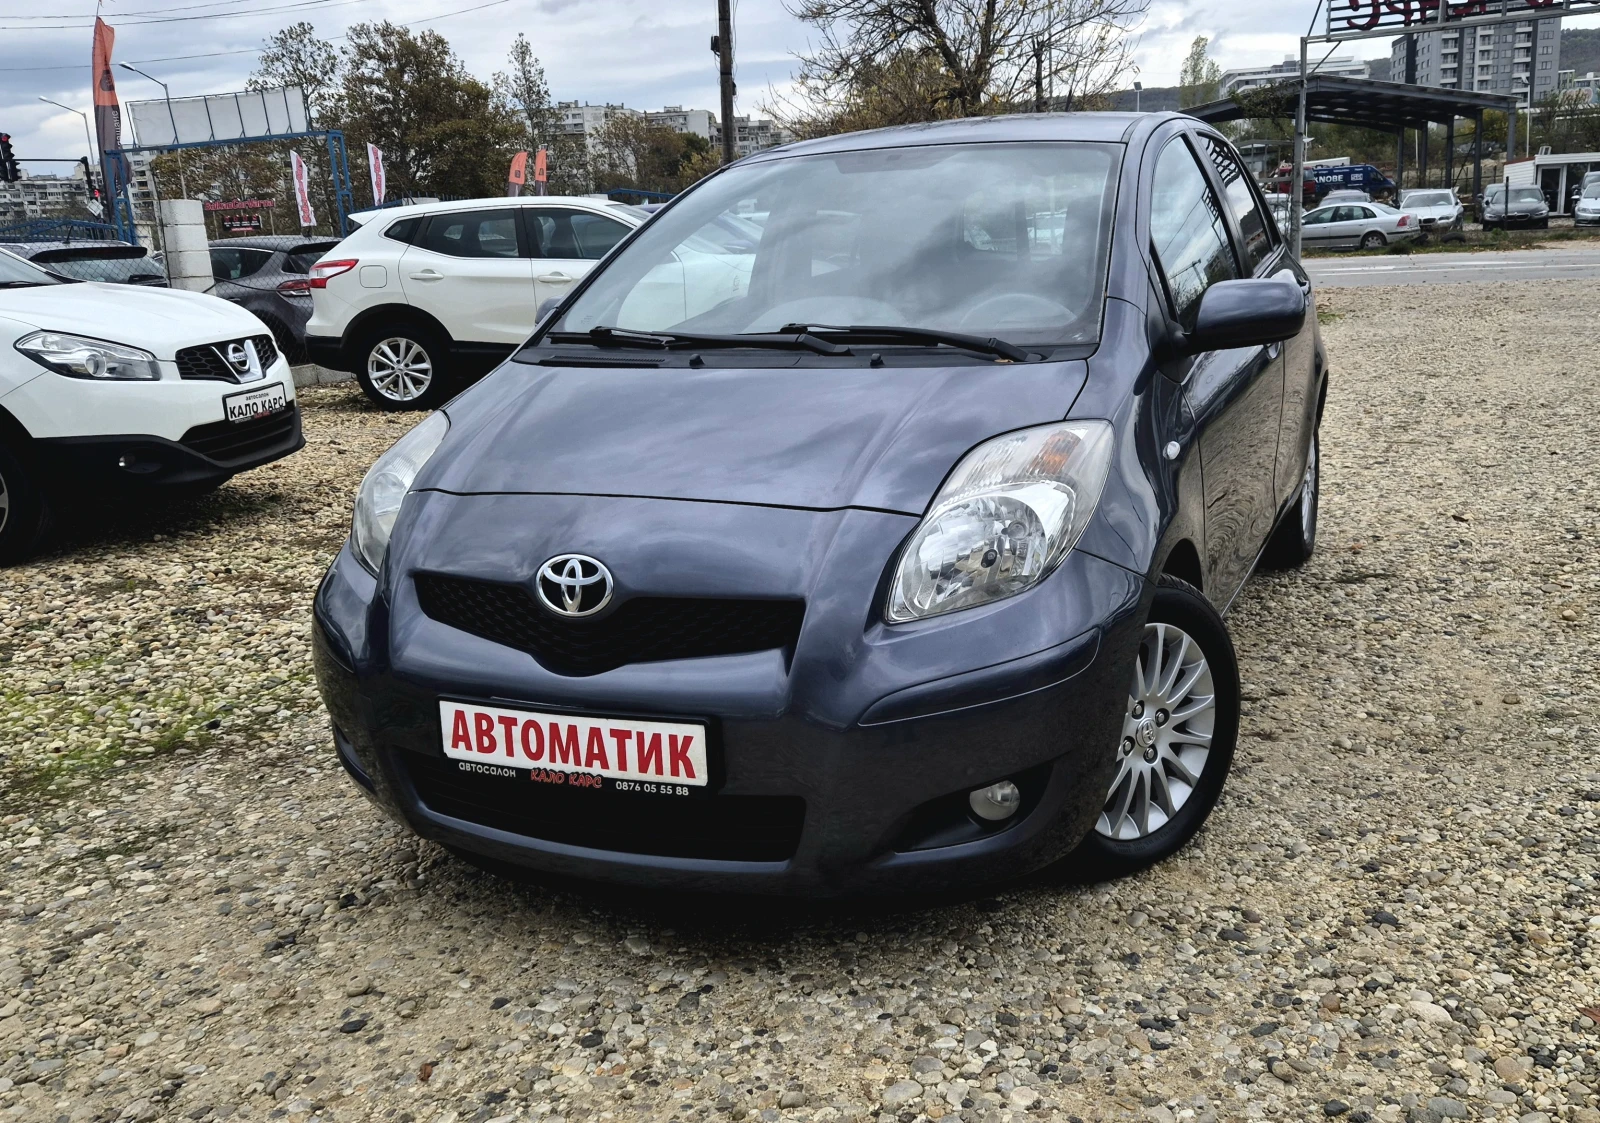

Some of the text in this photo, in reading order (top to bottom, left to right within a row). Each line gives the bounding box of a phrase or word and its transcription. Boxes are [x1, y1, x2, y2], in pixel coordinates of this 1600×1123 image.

[229, 402, 259, 419] КАЛО
[261, 396, 284, 412] КАРС
[245, 392, 269, 401] автосалон
[451, 709, 697, 779] АВТОМАТИК
[458, 761, 689, 796] автосалон КАЛО КАРС 0876 05 55 88
